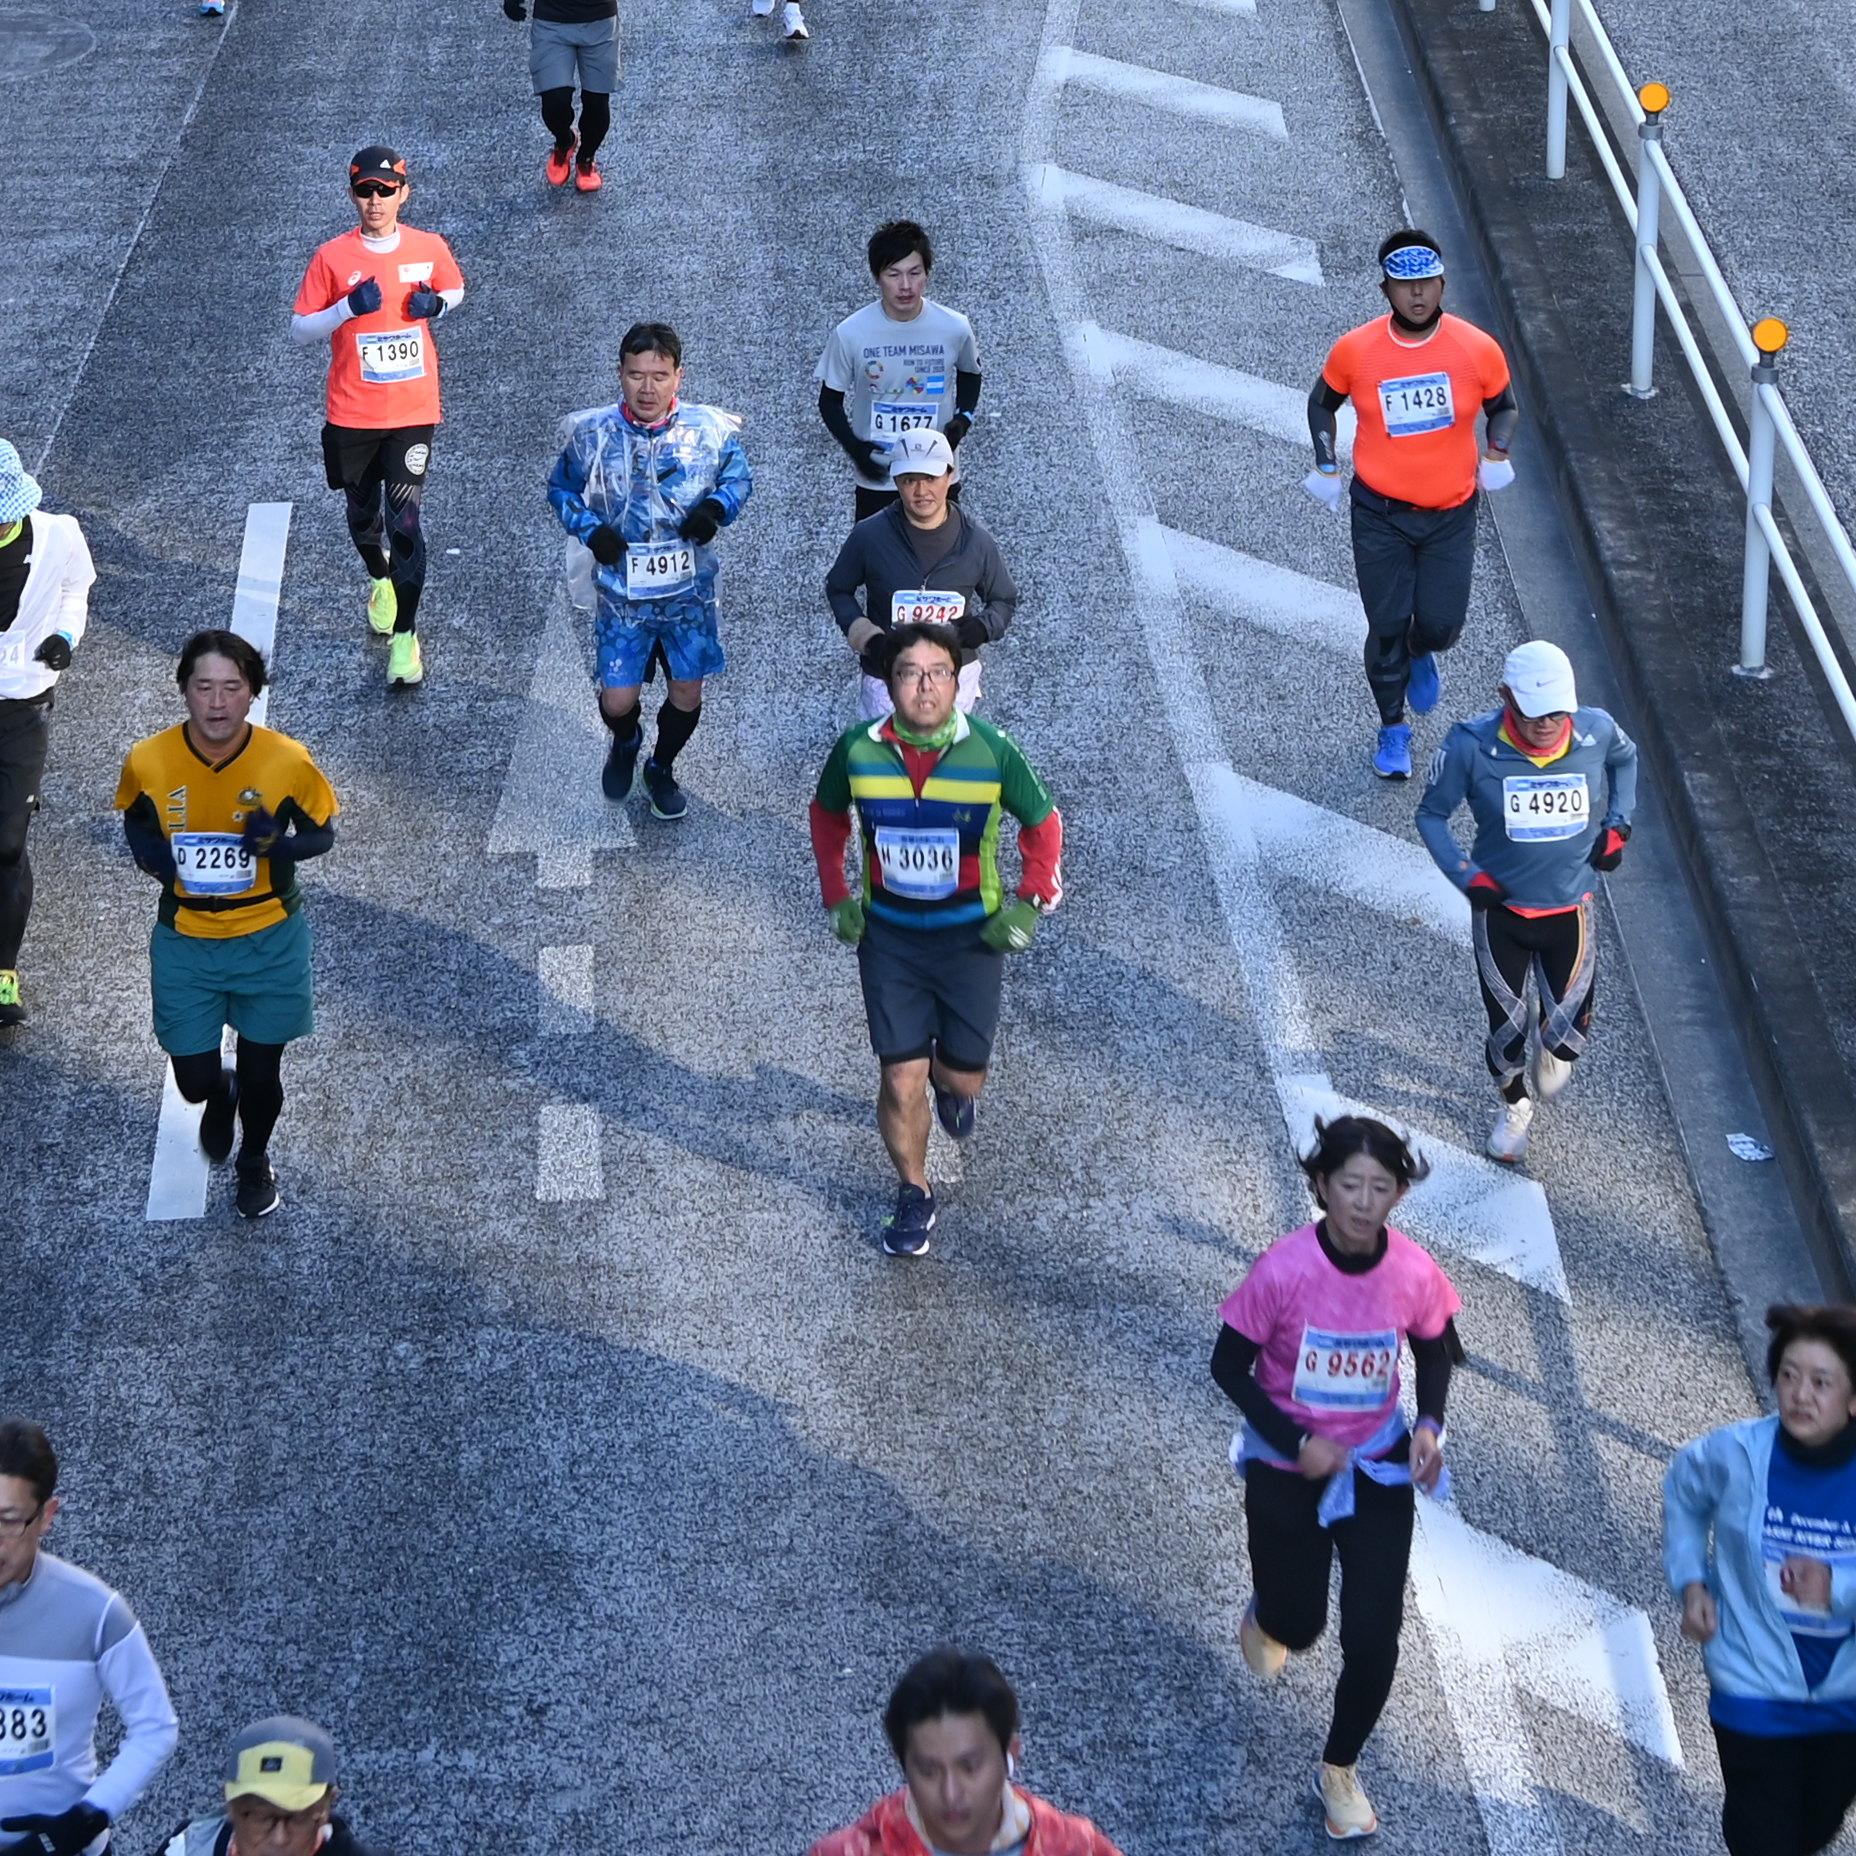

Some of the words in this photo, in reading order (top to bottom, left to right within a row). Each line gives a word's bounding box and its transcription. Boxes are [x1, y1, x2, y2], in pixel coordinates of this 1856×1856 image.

[363, 346, 369, 359] F
[376, 341, 419, 362] 1390
[864, 347, 881, 358] ONE
[882, 346, 905, 357] TEAM
[907, 344, 945, 356] MISAWA
[1385, 397, 1392, 412] F
[1400, 387, 1448, 411] 1428
[875, 414, 882, 428] G
[890, 414, 934, 432] 1677
[632, 558, 638, 573] F
[646, 551, 690, 576] 4912
[897, 608, 904, 622] G
[912, 605, 958, 623] 9242
[1510, 794, 1519, 814] G
[1530, 790, 1582, 815] 4920
[178, 847, 186, 866] D
[195, 846, 251, 871] 2269
[899, 845, 953, 873] 3036
[1304, 1350, 1317, 1373] G
[1327, 1350, 1392, 1379] 9562
